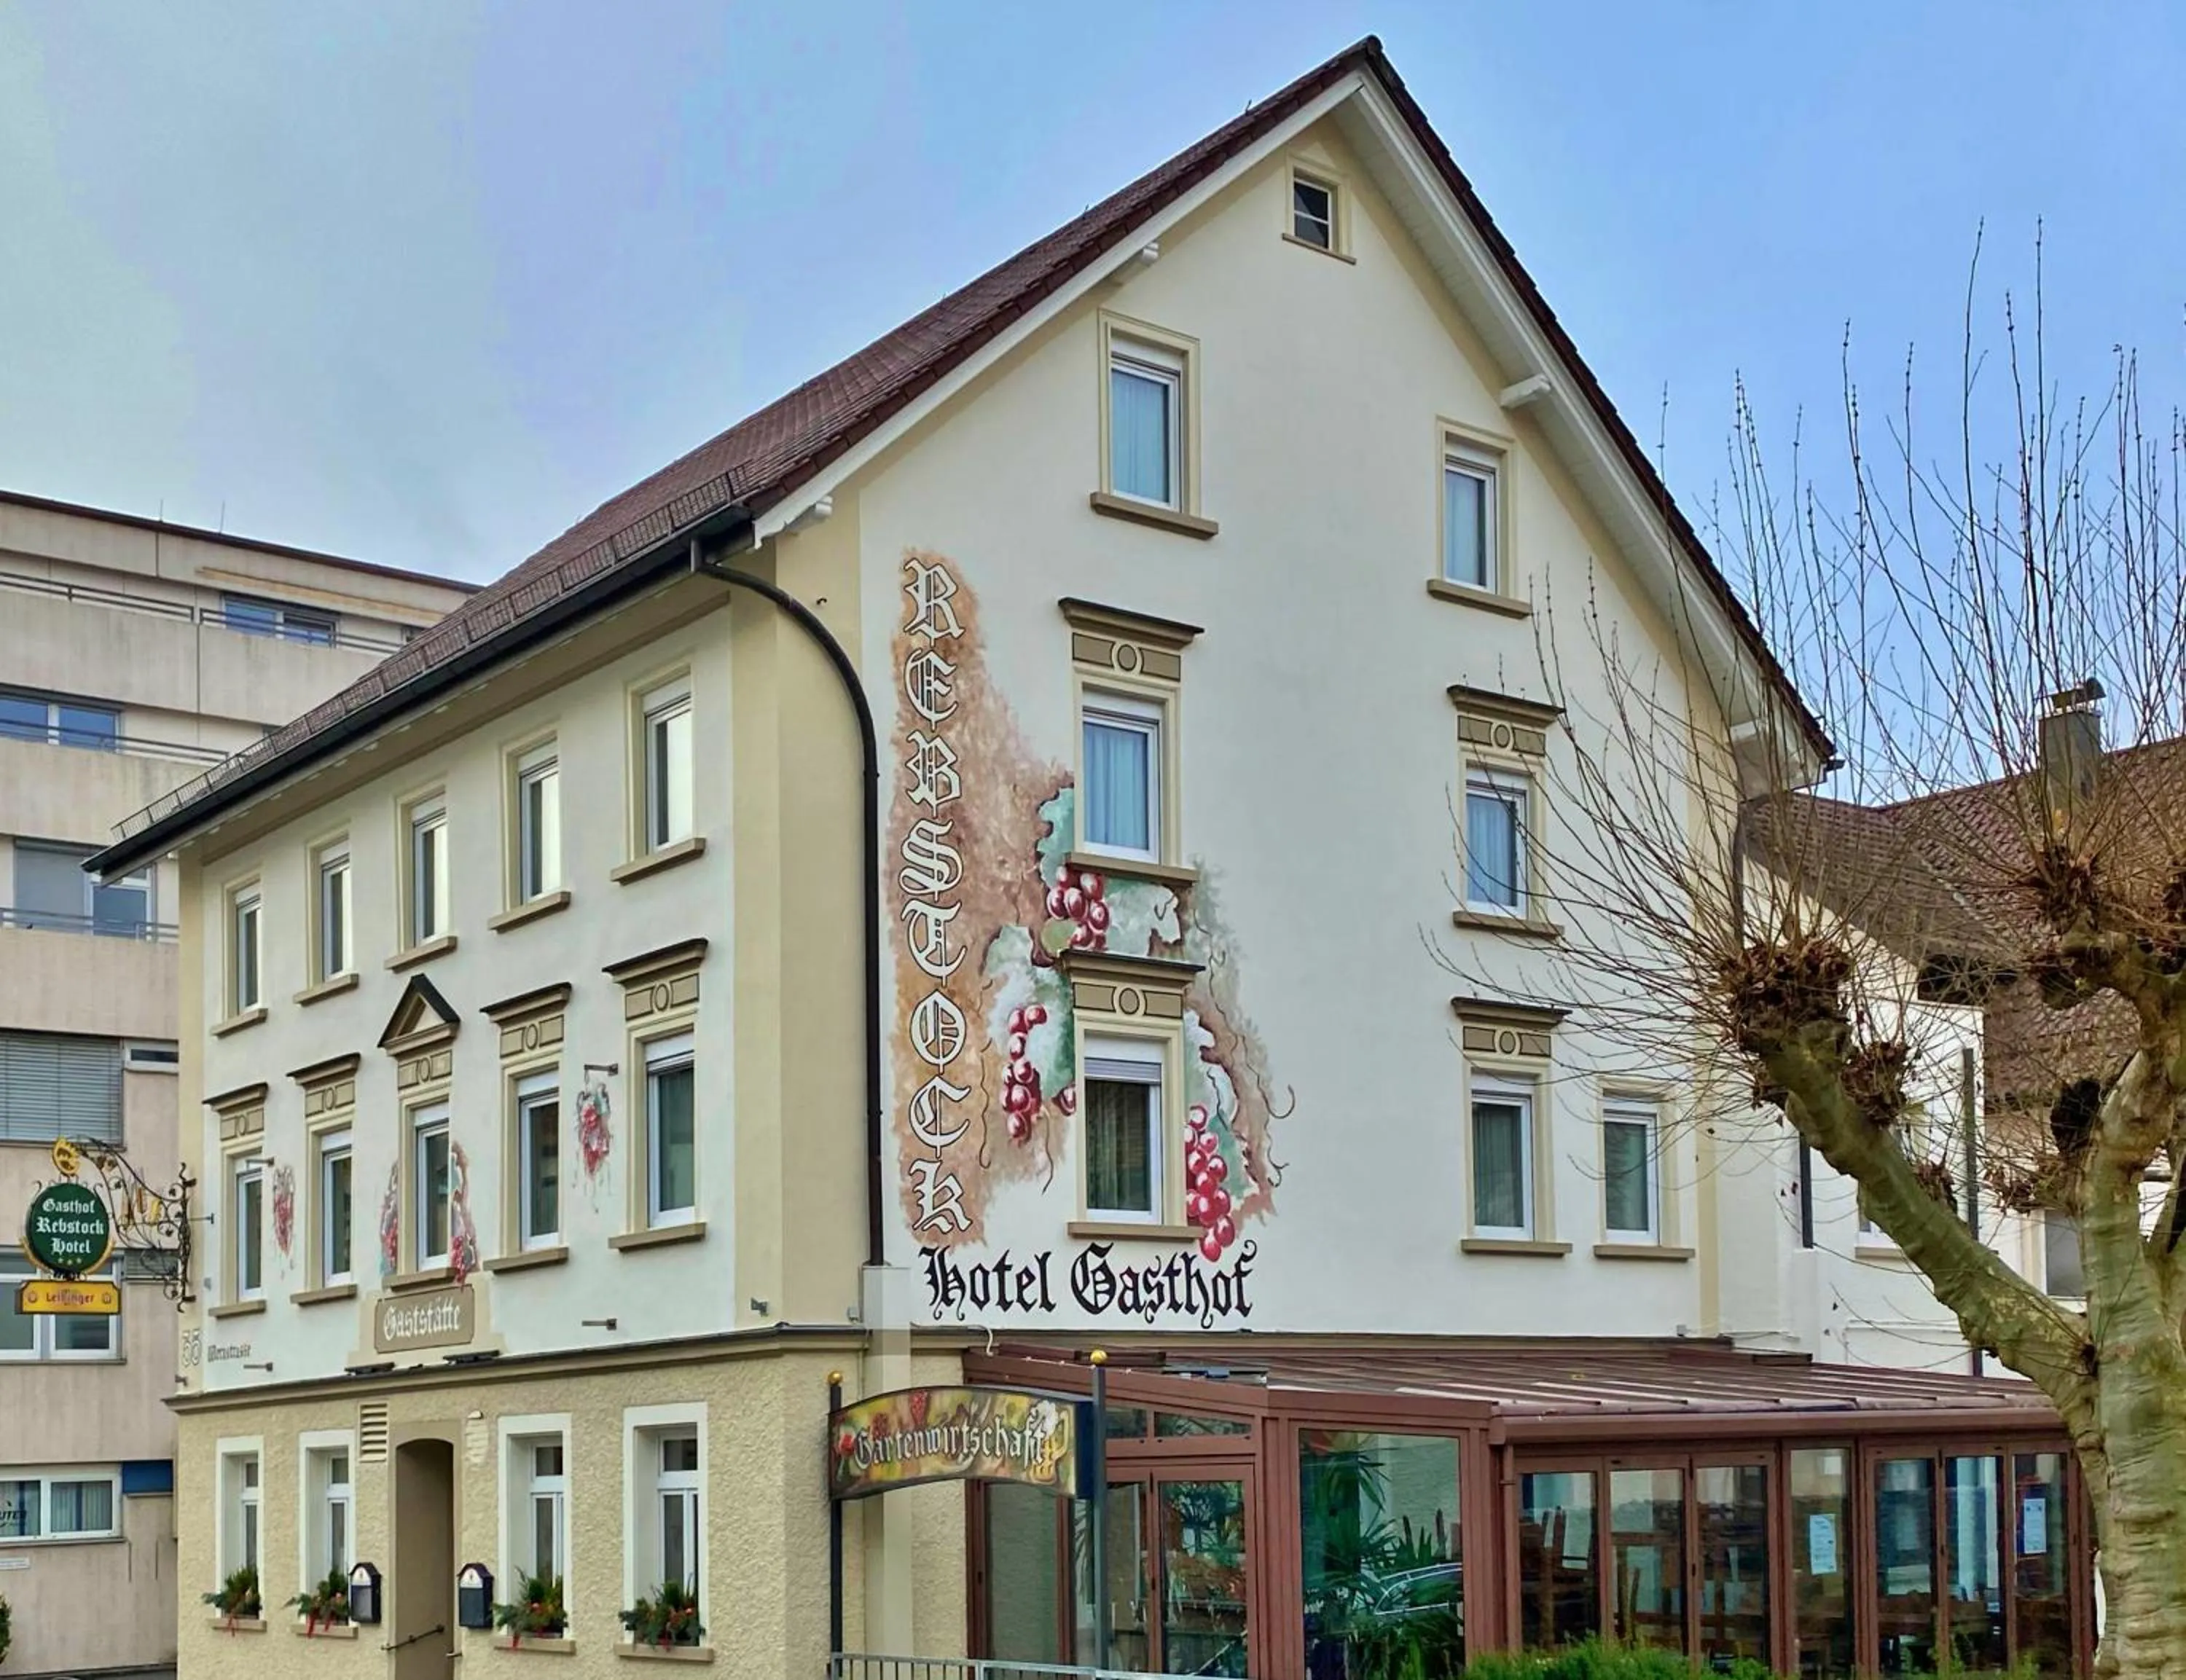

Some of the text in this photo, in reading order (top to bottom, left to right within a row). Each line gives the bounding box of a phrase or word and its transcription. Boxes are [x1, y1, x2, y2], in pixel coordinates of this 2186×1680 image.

[898, 557, 973, 1234] REBSTOCK
[36, 1216, 105, 1235] Rebstock
[42, 1198, 95, 1214] Gasthof
[50, 1237, 92, 1256] Hotel
[917, 1239, 1258, 1330] Hotel Gasthof
[383, 1296, 461, 1341] Gaststätte
[854, 1413, 1046, 1470] Gartenwirtschaft
